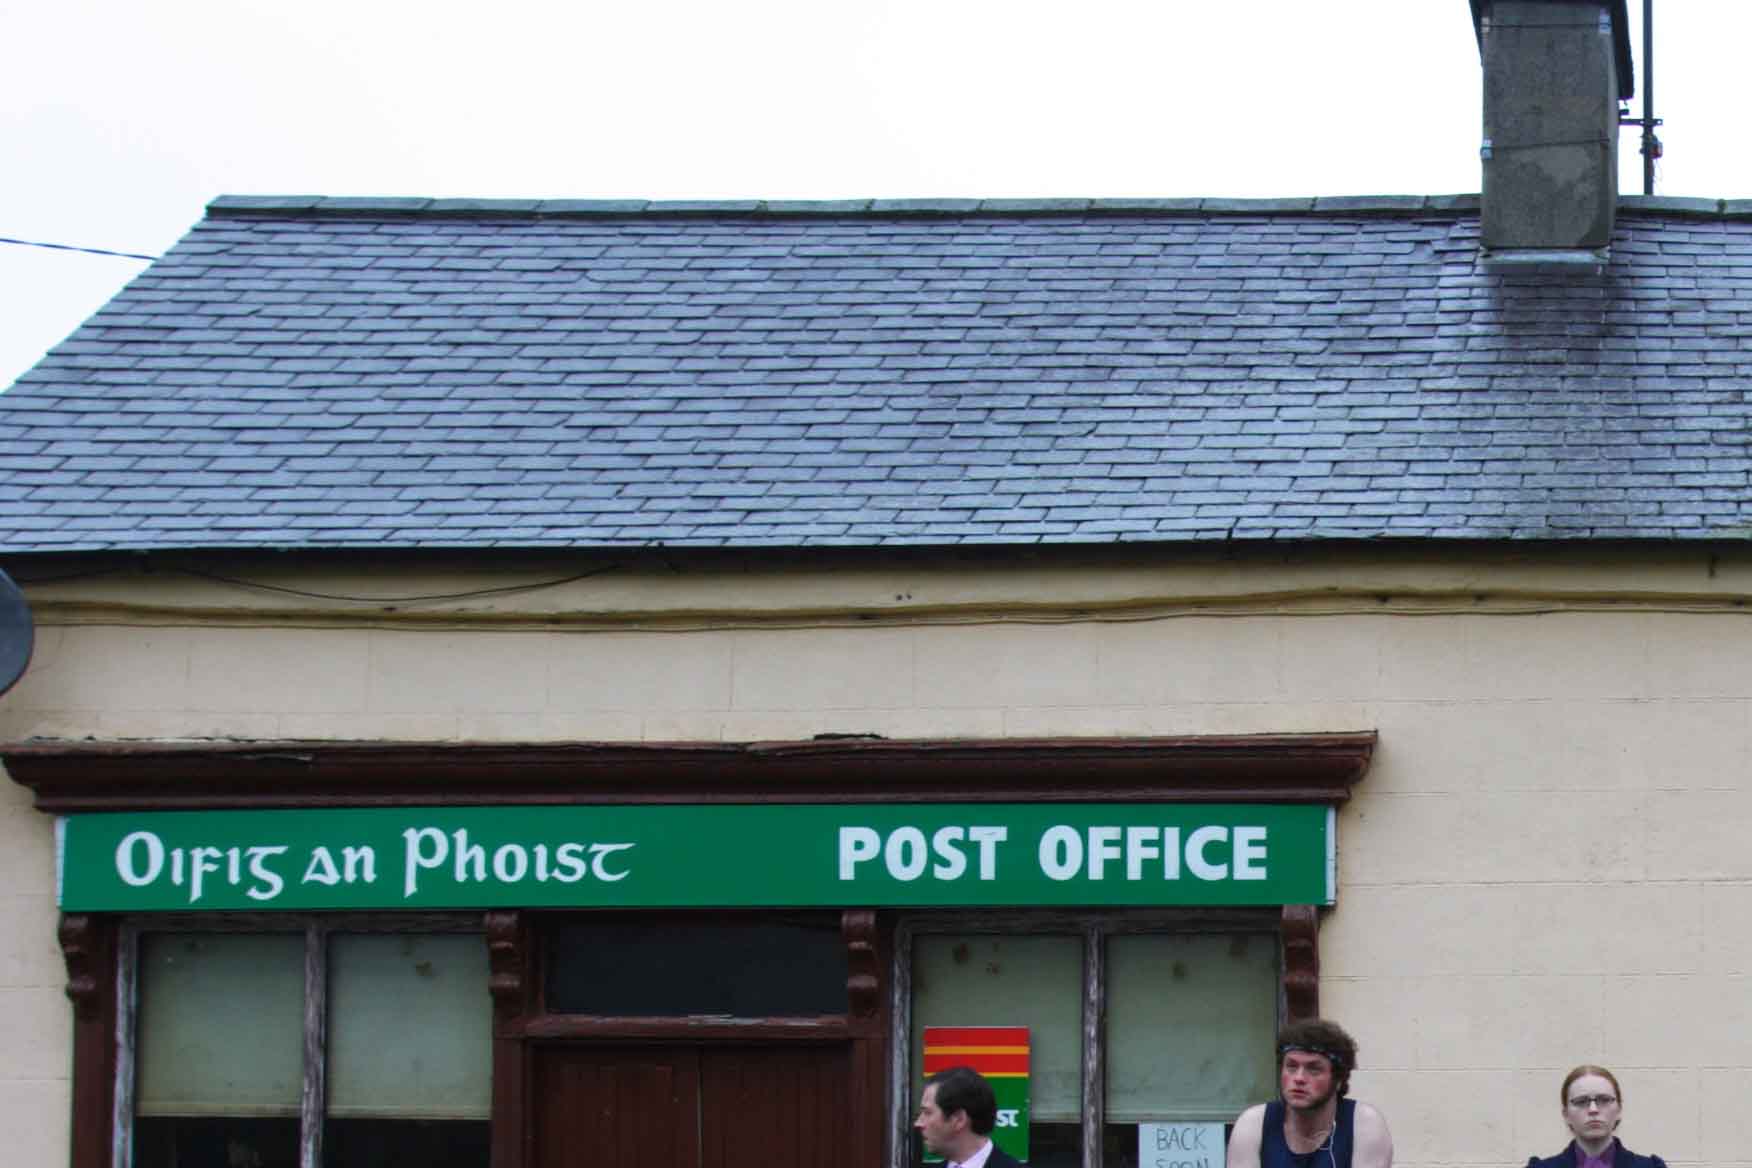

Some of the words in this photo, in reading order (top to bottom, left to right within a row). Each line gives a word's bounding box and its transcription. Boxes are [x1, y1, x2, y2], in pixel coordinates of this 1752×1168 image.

[115, 831, 288, 903] Oifig
[302, 844, 377, 886] an
[402, 827, 636, 898] Phoist
[839, 825, 1008, 881] POST
[1039, 825, 1267, 881] OFFICE
[1155, 1127, 1207, 1151] BACK
